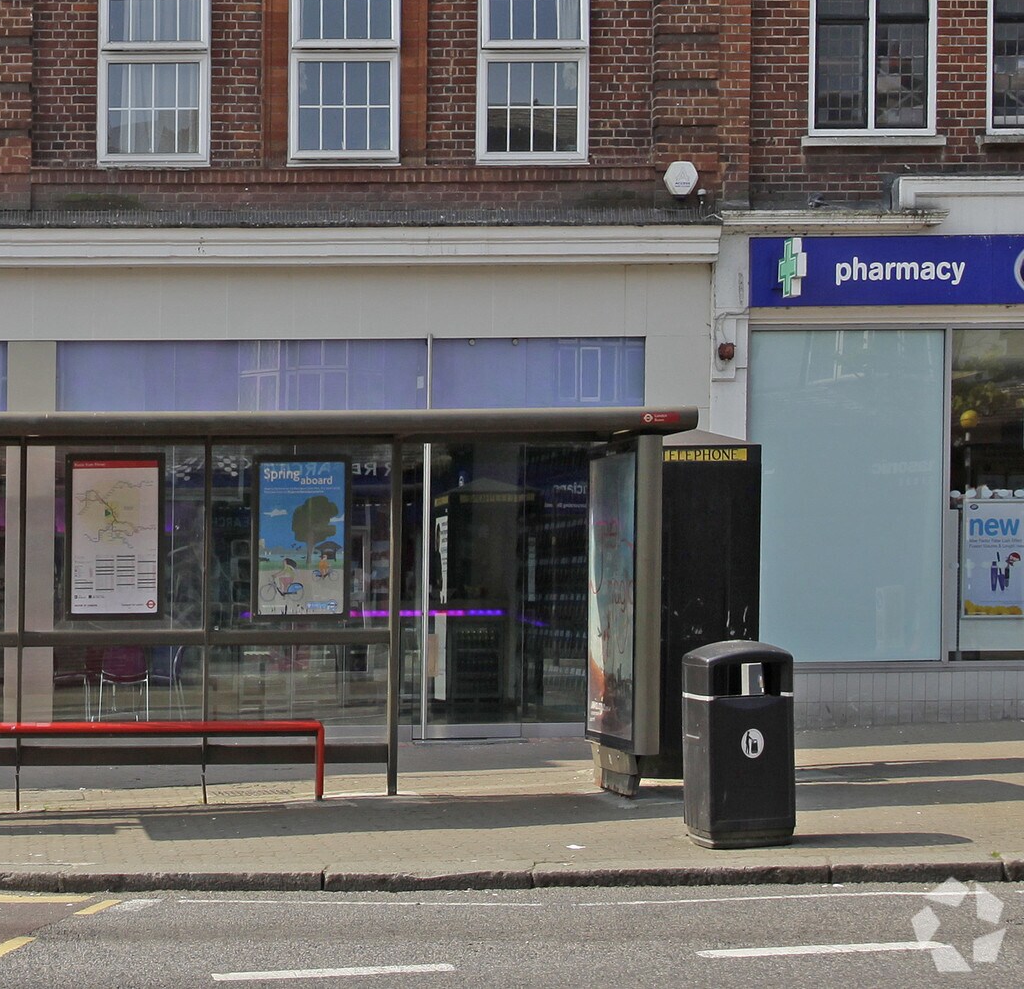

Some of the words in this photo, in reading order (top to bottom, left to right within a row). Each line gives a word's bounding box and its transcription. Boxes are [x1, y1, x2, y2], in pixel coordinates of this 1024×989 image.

[835, 256, 966, 286] pharmacy
[263, 467, 301, 482] Spring
[300, 476, 333, 485] aboard
[969, 517, 1020, 536] new
